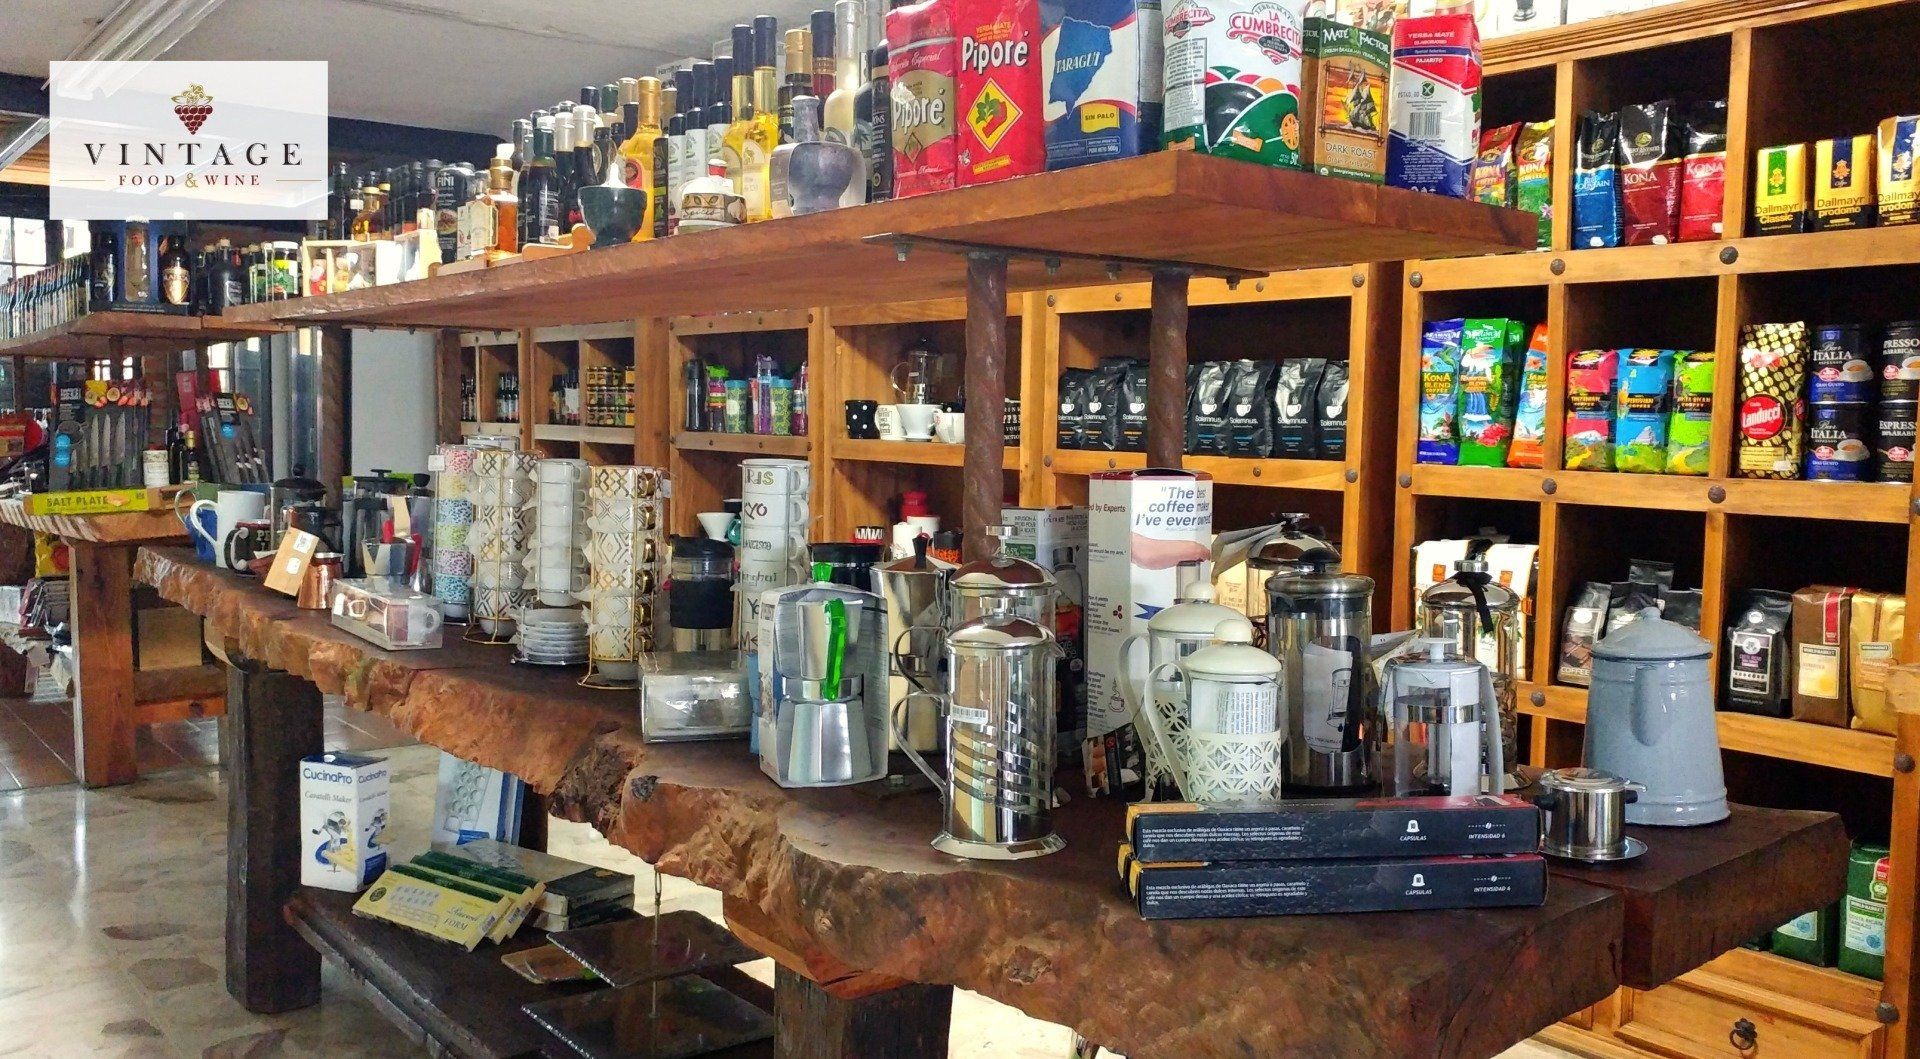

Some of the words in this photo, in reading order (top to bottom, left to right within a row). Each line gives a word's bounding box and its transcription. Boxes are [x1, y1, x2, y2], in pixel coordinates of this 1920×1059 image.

[1269, 10, 1279, 20] LA
[1357, 31, 1391, 55] FACTOR
[962, 30, 1029, 75] Piporé
[1097, 112, 1115, 120] PALO
[1325, 142, 1349, 155] DARK
[1350, 146, 1378, 159] ROAST
[1518, 163, 1545, 175] KONA
[1686, 162, 1725, 176] KONA
[1623, 172, 1658, 186] KONA
[1756, 202, 1799, 215] Dallmayr
[1817, 195, 1865, 209] Dallmayr
[1818, 206, 1862, 218] prodomo
[1759, 213, 1794, 225] Classic
[1812, 350, 1853, 362] ITALIA
[1423, 372, 1452, 382] KONA
[1742, 402, 1781, 428] Landucci
[1879, 420, 1916, 430] ESPRES
[1810, 427, 1848, 439] ITALIA
[46, 496, 72, 508] SALT
[75, 495, 109, 505] PLATE
[1148, 500, 1195, 513] coffee
[1095, 503, 1103, 514] by
[1103, 503, 1127, 514] Experts
[1135, 513, 1162, 526] I've
[1166, 516, 1197, 526] ever
[1560, 666, 1590, 676] COFFEE
[303, 767, 353, 784] CucinaPro
[357, 769, 387, 784] CucinaPro
